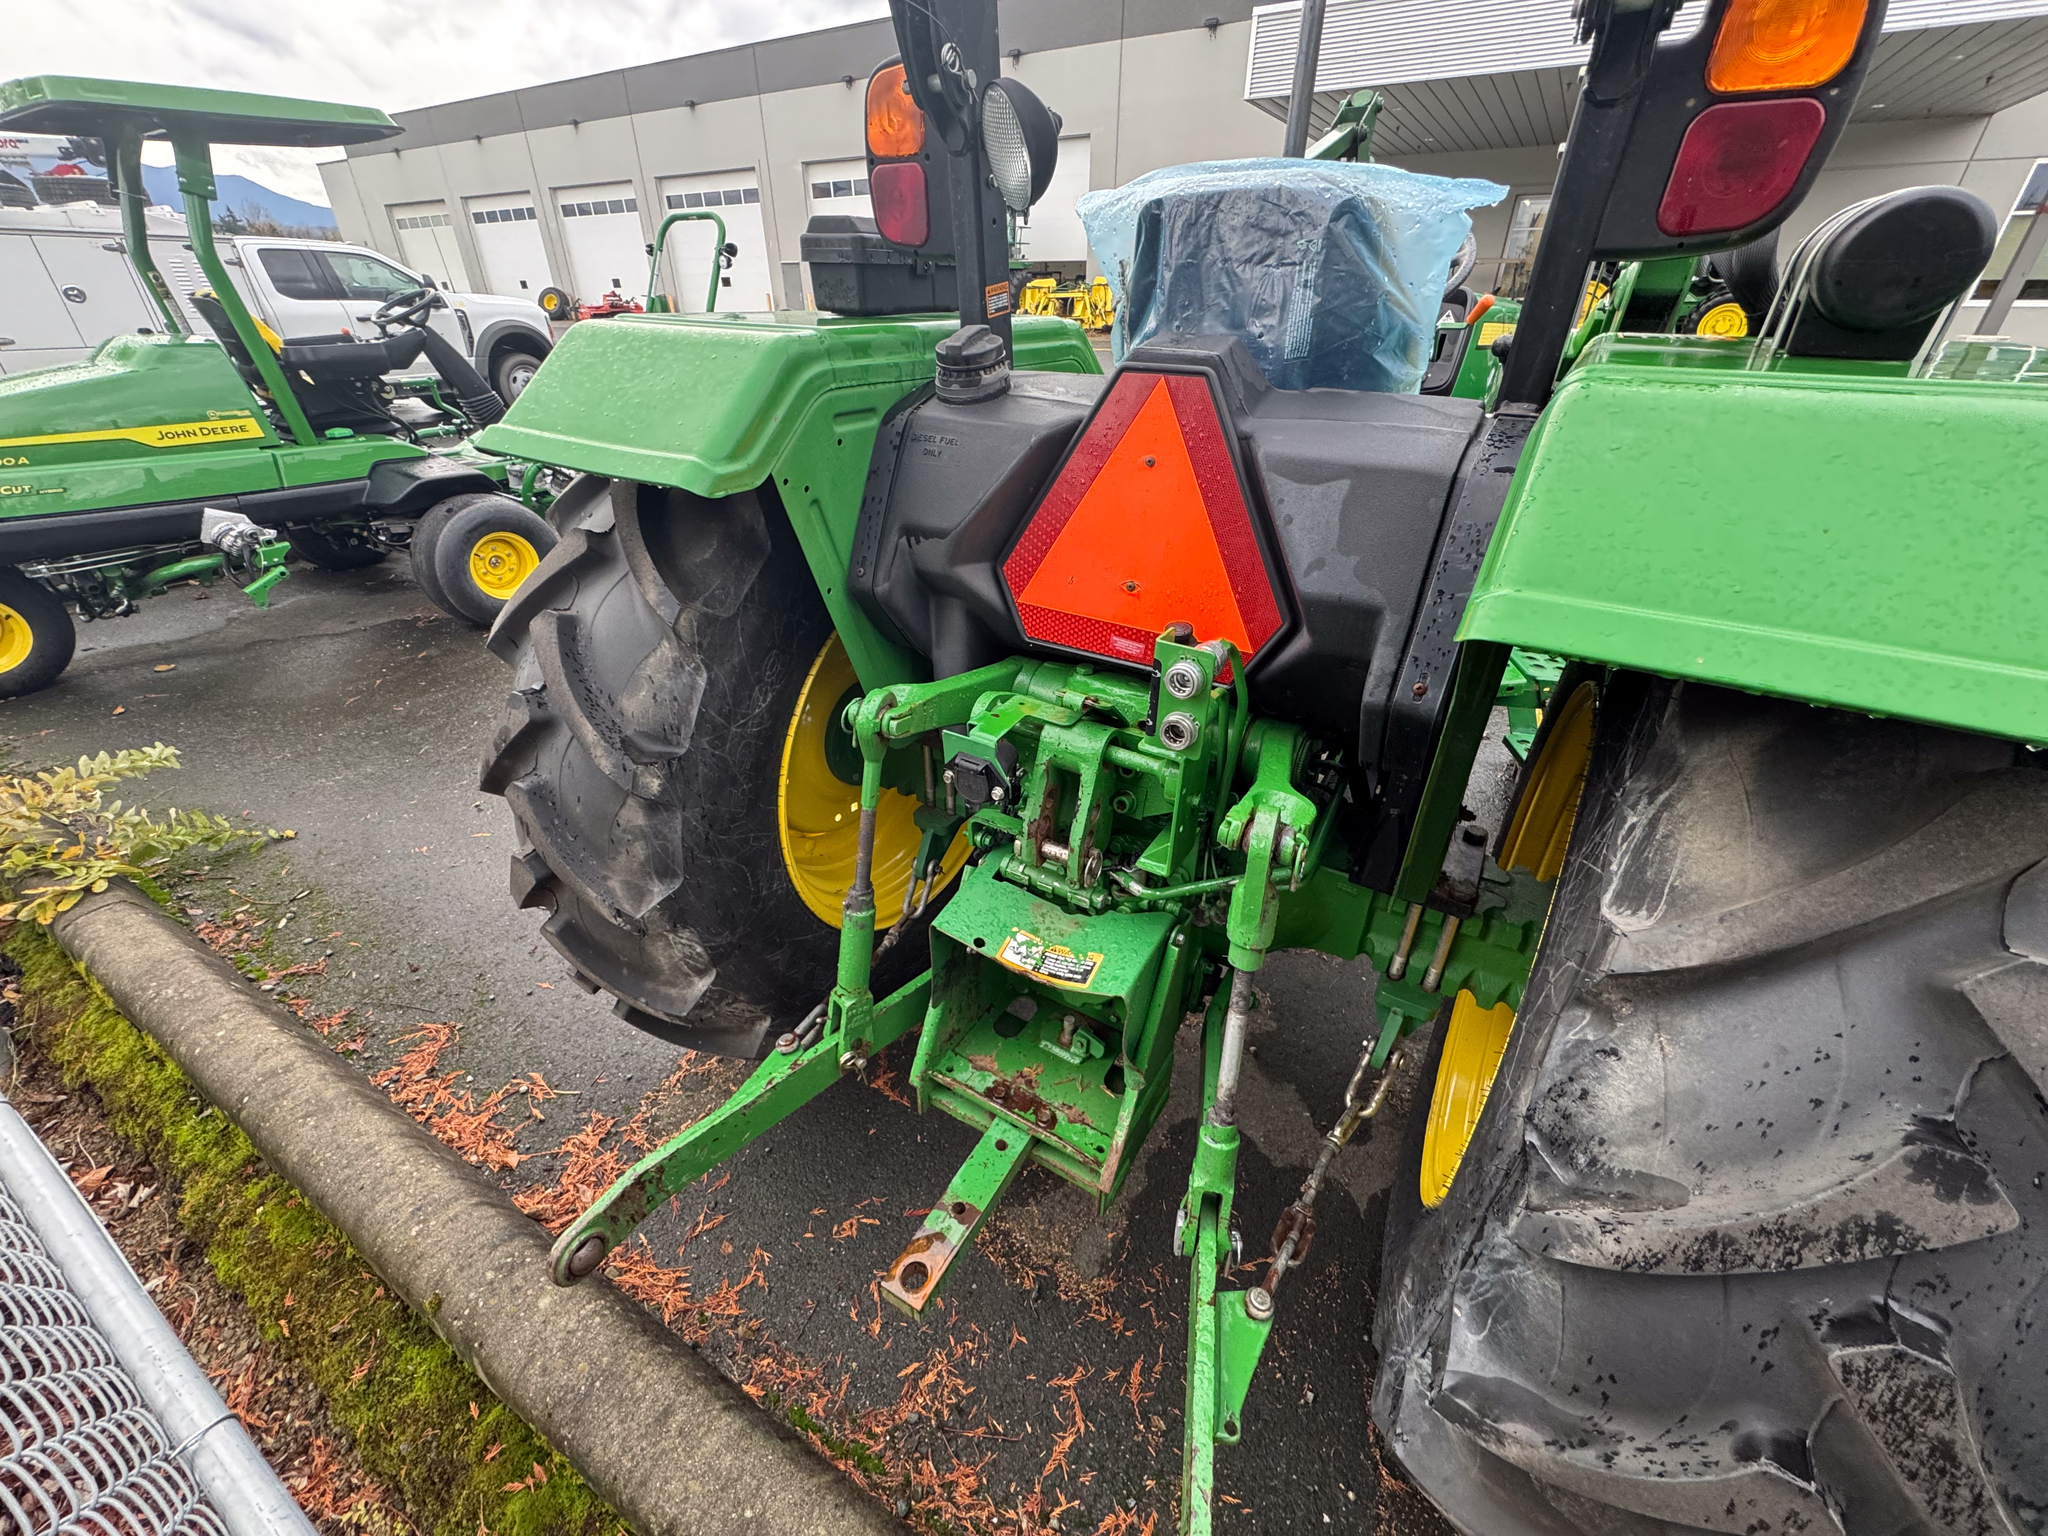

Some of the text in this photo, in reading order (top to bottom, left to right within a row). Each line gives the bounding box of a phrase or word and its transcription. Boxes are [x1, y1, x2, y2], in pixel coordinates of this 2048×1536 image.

[157, 424, 249, 441] JOHN DEERE
[939, 436, 959, 447] FUEL
[922, 447, 943, 458] ONLY
